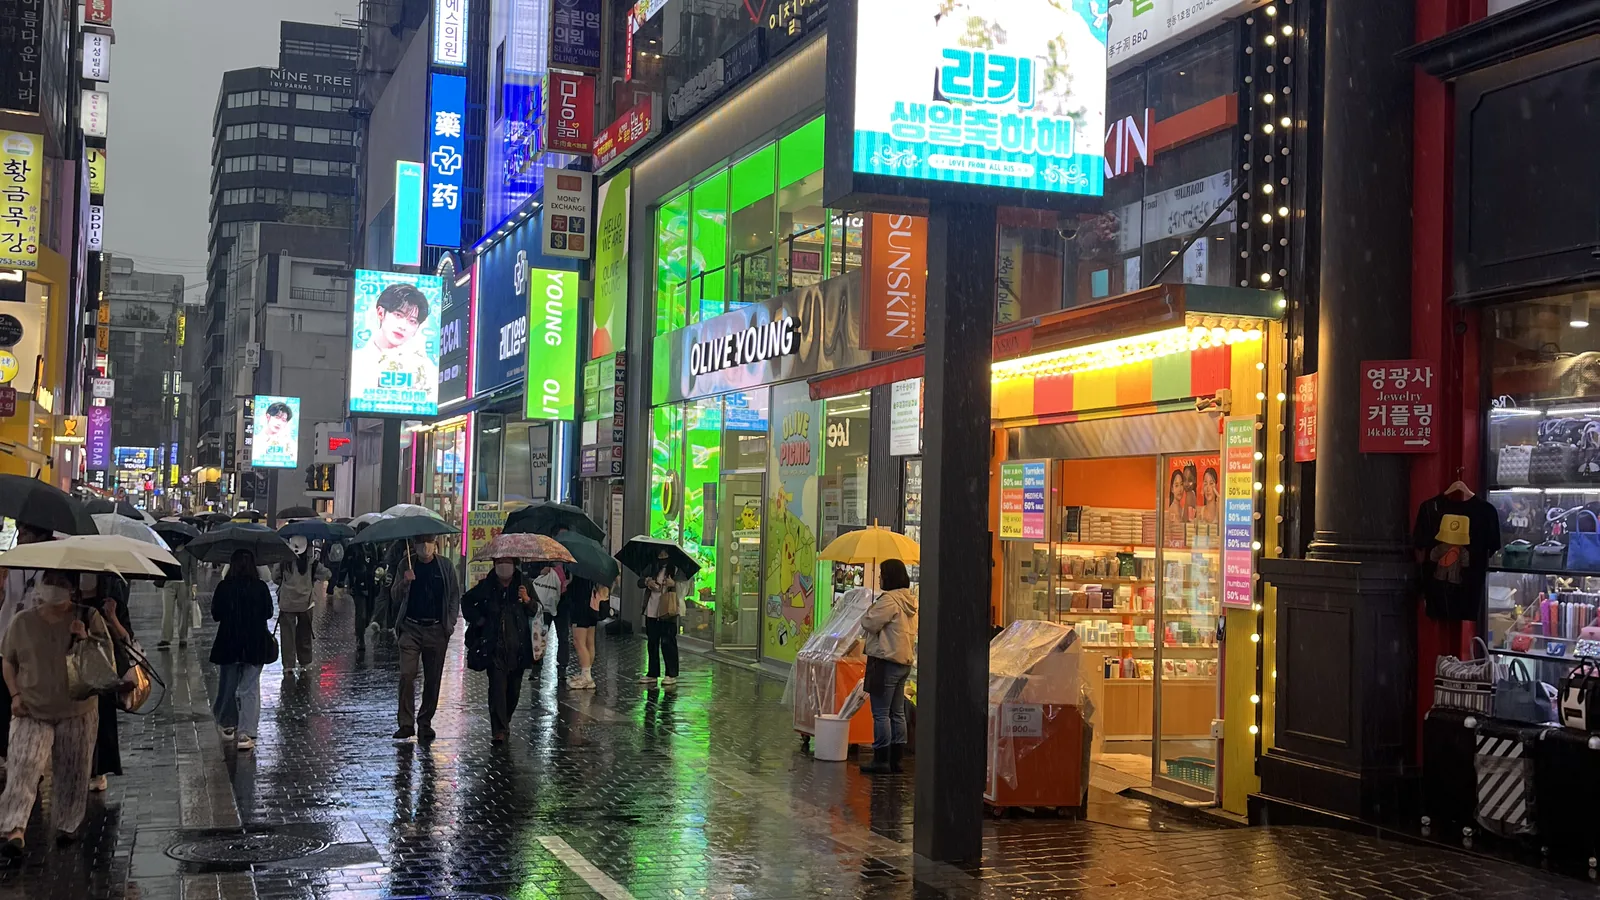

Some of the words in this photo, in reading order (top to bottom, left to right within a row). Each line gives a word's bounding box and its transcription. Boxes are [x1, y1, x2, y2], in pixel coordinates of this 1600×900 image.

[555, 7, 600, 28] 슬림영
[554, 26, 584, 46] 의원
[1132, 29, 1148, 46] BBQ
[554, 45, 572, 54] SLIM
[574, 48, 600, 58] YOUNG
[554, 54, 578, 64] CLINIC
[313, 73, 352, 87] TREE
[941, 48, 1036, 109] 리키
[889, 101, 1074, 156] 생일축하해
[948, 158, 966, 168] LOVE
[968, 160, 986, 169] FROM
[432, 183, 459, 210] 药
[557, 195, 580, 203] MONEY
[1, 158, 31, 252] 황금목장
[551, 203, 586, 212] EXCHANGE
[90, 207, 101, 244] apple
[886, 212, 913, 338] SUNSKIN
[544, 272, 564, 346] YOUNG
[690, 333, 732, 376] OLIVE
[734, 315, 796, 368] YOUNG
[380, 371, 412, 387] 리키
[1367, 366, 1434, 390] 영광사
[542, 379, 560, 420] OLI
[1376, 390, 1422, 404] Jewelry
[616, 401, 625, 413] $
[1368, 404, 1432, 426] 커플링
[783, 411, 810, 441] OLIVE
[1400, 428, 1414, 436] 24k
[1417, 427, 1431, 437] 교환
[1230, 435, 1242, 444] 50%
[92, 430, 104, 466] ELFBAR
[780, 440, 810, 467] PICNIC
[613, 462, 622, 473] $
[1229, 461, 1240, 470] 50%
[1024, 478, 1035, 486] 50%
[1228, 487, 1240, 496] 50%
[1228, 501, 1250, 510] Torriden
[1228, 513, 1240, 522] 50%
[1002, 526, 1012, 534] 50%
[1024, 526, 1034, 534] 50%
[1228, 538, 1240, 548] 50%
[1227, 564, 1239, 574] 50%
[1226, 590, 1238, 600] 50%
